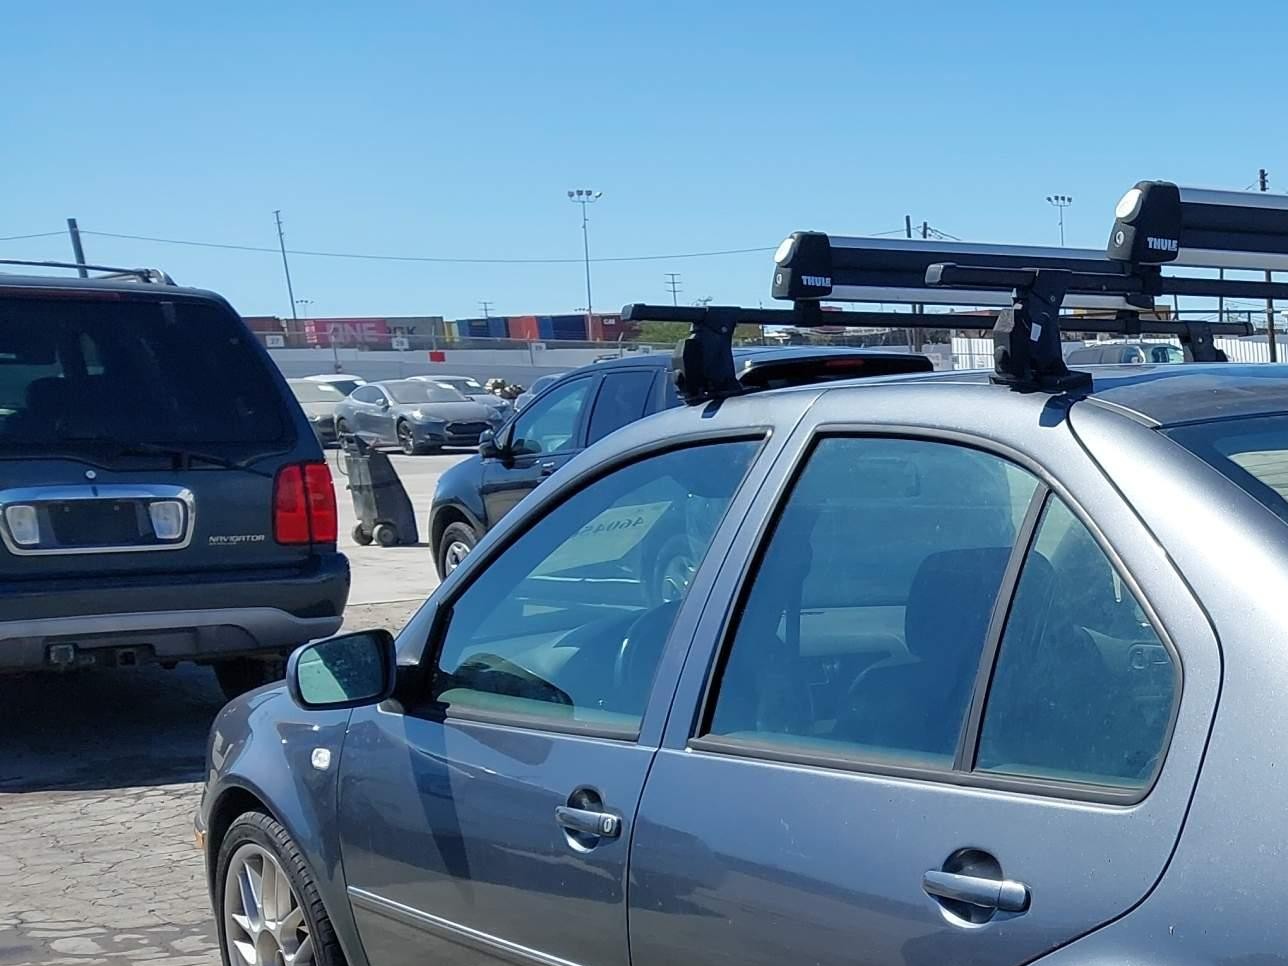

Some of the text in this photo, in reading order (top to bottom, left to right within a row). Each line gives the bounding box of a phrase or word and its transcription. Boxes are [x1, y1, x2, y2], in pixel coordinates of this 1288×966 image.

[1147, 236, 1178, 252] THULE
[801, 275, 832, 288] THULE
[208, 534, 265, 543] NAVIGATOR
